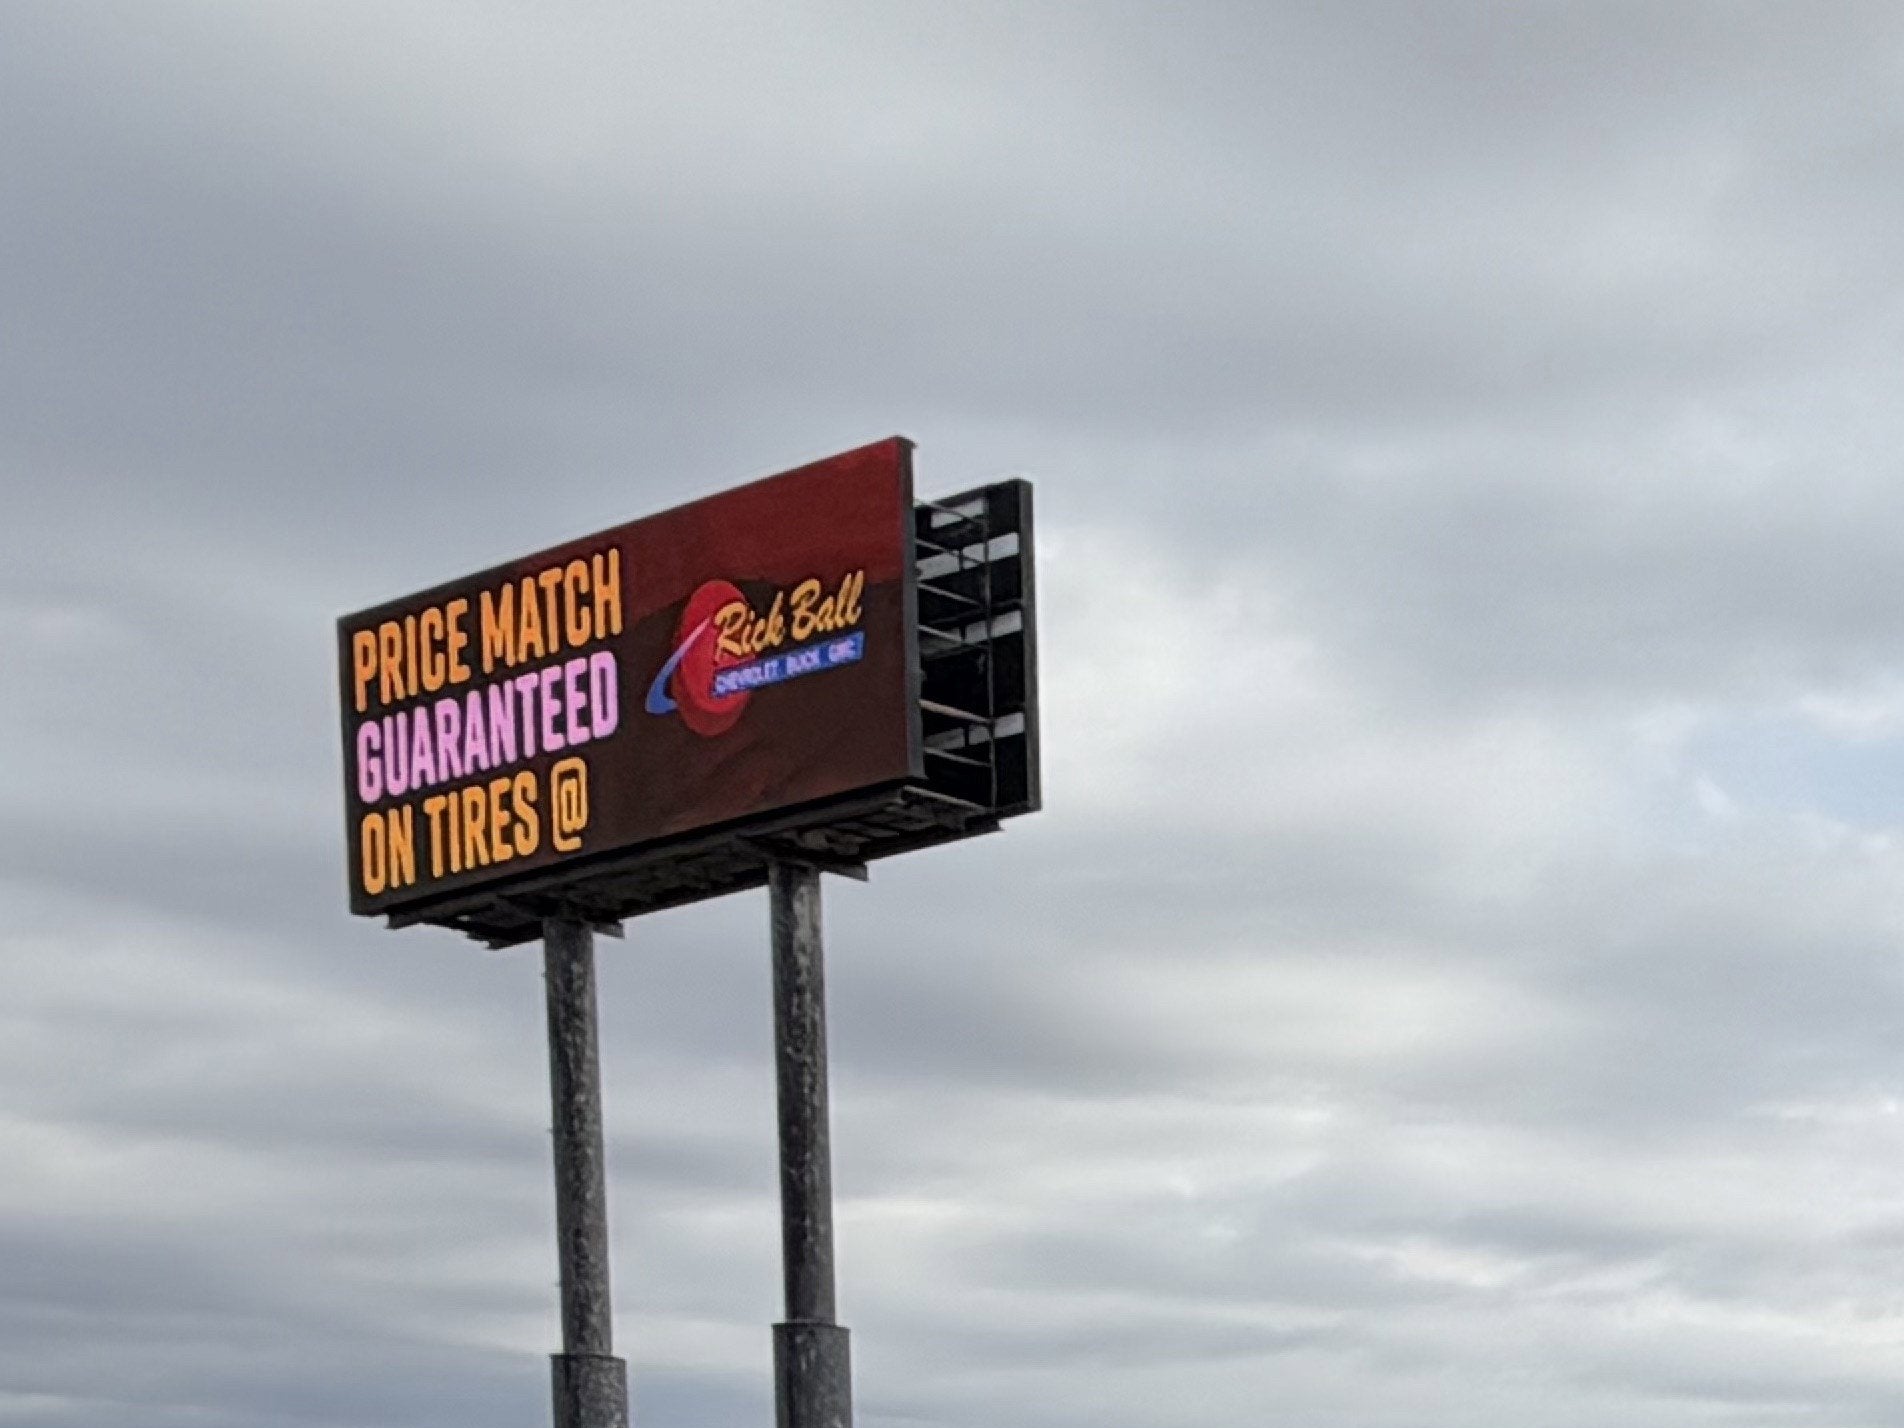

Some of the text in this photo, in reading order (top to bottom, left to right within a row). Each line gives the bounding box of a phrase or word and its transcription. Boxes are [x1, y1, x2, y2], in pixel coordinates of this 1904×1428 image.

[353, 548, 623, 712] PRICE MATCH
[713, 569, 865, 662] Rick Ball
[357, 650, 620, 803] GUARANTEED
[362, 757, 588, 896] ON TIRES @
